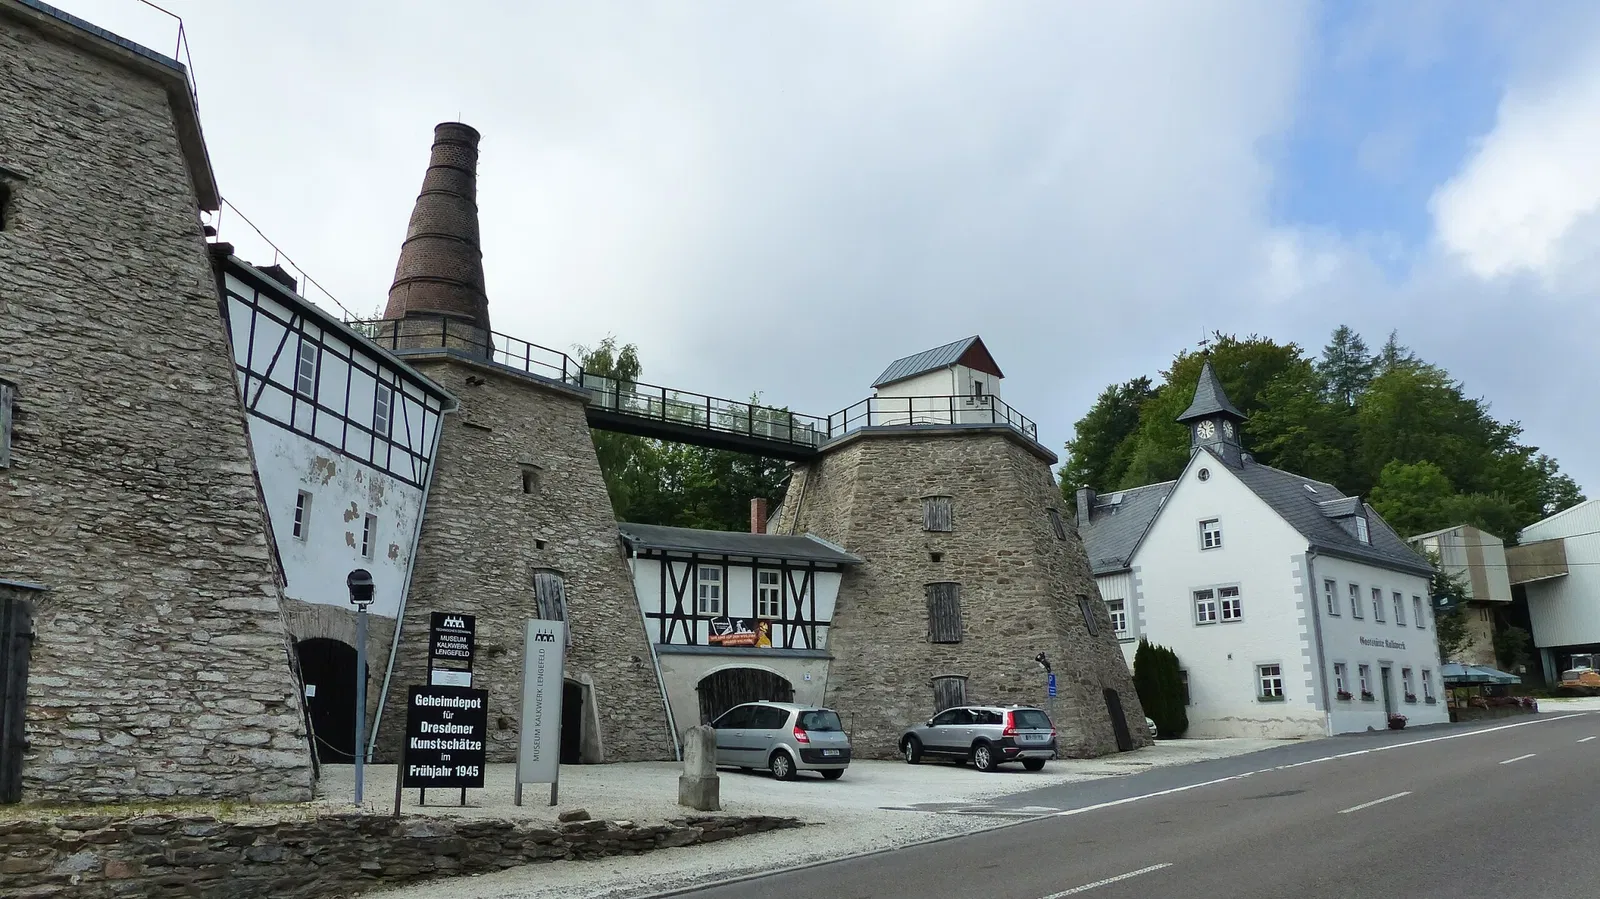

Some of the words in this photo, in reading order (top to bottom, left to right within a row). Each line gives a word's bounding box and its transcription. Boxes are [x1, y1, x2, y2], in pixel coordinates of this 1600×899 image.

[436, 642, 469, 650] KALKWERK
[440, 635, 467, 643] MUSEUM
[435, 649, 470, 657] LENGEFELD
[537, 648, 546, 687] LENGEFELD
[415, 694, 482, 711] Geheimdepot
[535, 689, 544, 727] KALKWERK
[443, 710, 454, 719] für
[420, 721, 474, 735] Dresdener
[410, 737, 482, 751] Kunstschätze
[533, 728, 541, 762] MUSEUM
[440, 752, 451, 761] im
[409, 765, 453, 779] Frühjahr
[455, 765, 479, 777] 1945
